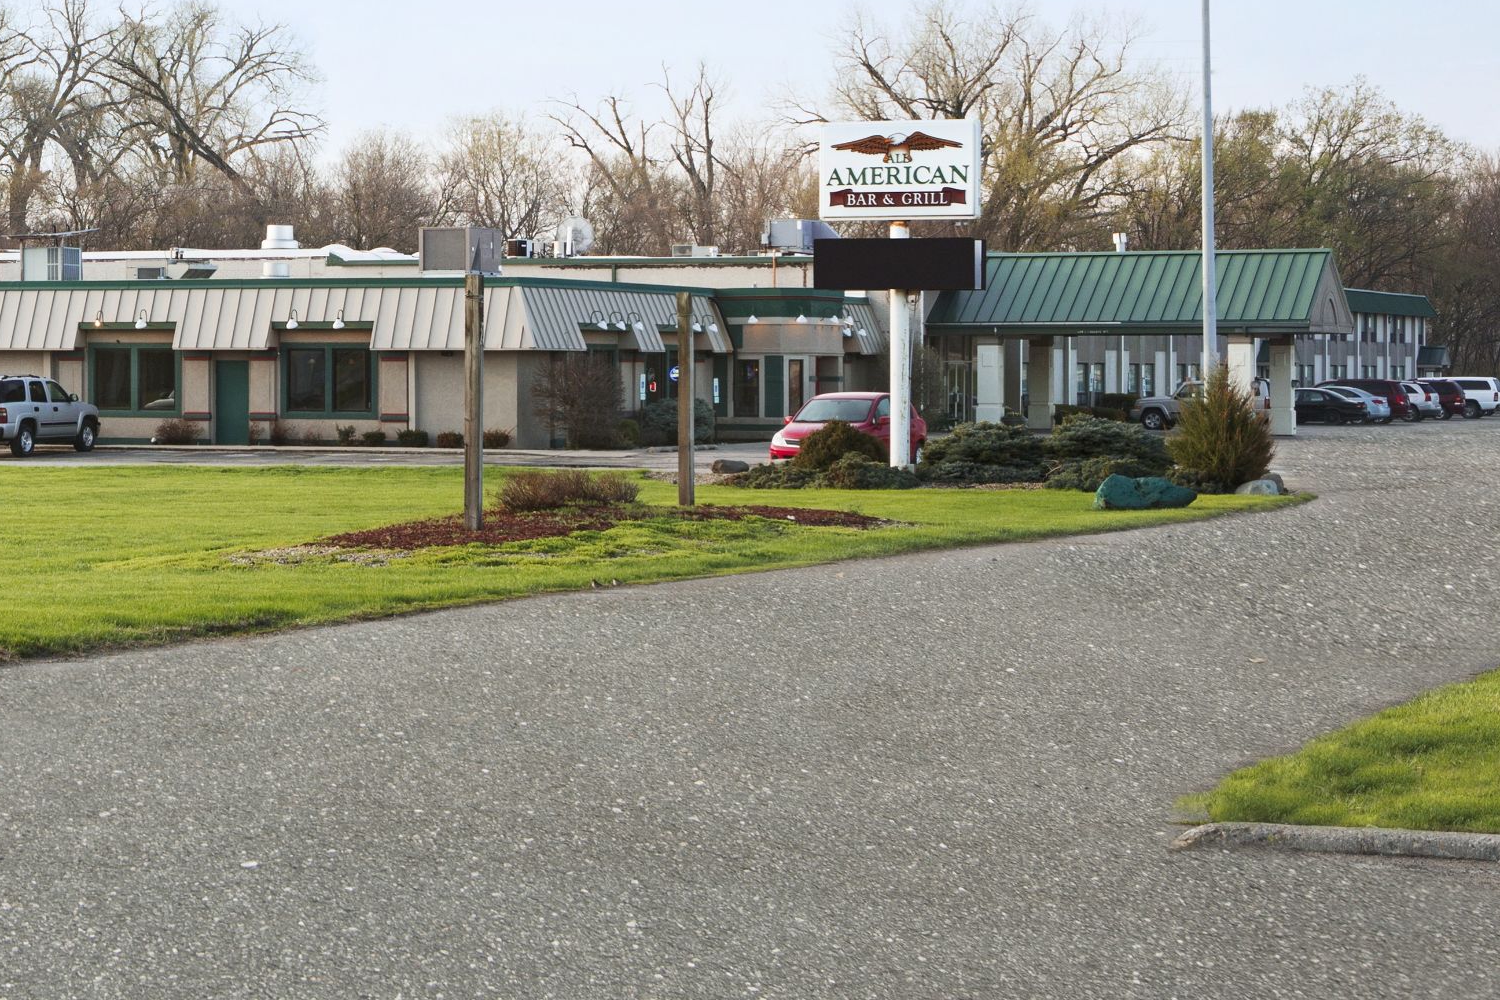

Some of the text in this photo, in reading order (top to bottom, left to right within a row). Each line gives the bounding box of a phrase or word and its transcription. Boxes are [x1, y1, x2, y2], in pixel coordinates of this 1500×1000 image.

[826, 164, 970, 187] AMERICAN
[847, 192, 949, 206] BAR & GRILL
